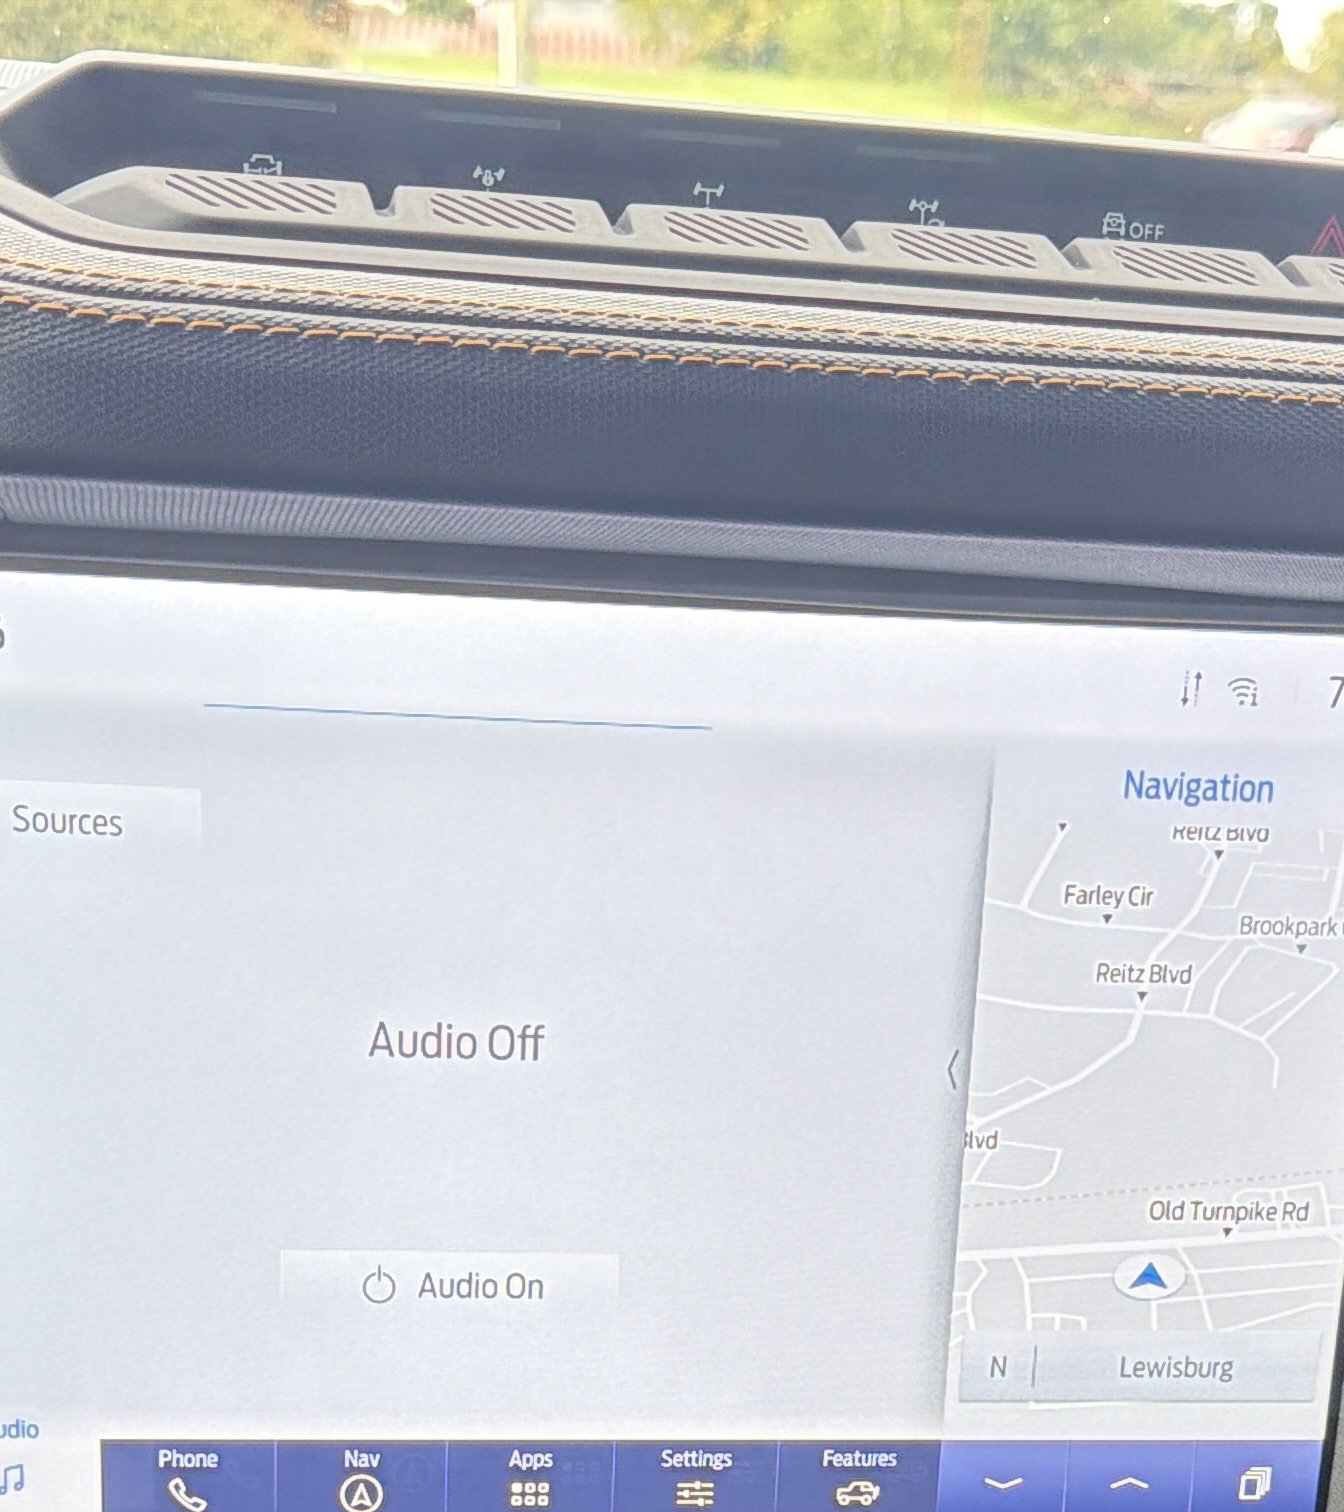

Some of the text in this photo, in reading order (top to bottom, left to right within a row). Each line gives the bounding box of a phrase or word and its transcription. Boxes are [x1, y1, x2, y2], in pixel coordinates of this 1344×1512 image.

[1129, 223, 1165, 239] OFF
[1123, 769, 1274, 806] Navigation
[12, 804, 123, 837] Sources
[1063, 885, 1154, 910] Farley Cir
[1239, 916, 1336, 938] Brookpark
[1096, 963, 1193, 985] Reitz Blvd
[368, 1021, 546, 1062] Audio Off
[1149, 1200, 1310, 1225] Old Turnpike Rd
[418, 1272, 544, 1299] Audio On
[990, 1356, 1007, 1378] N
[1119, 1356, 1233, 1382] Lewisburg
[159, 1449, 218, 1469] Phone
[344, 1450, 380, 1468] Nav
[509, 1450, 554, 1472] Apps
[660, 1448, 733, 1472] Settings
[823, 1449, 898, 1469] Features
